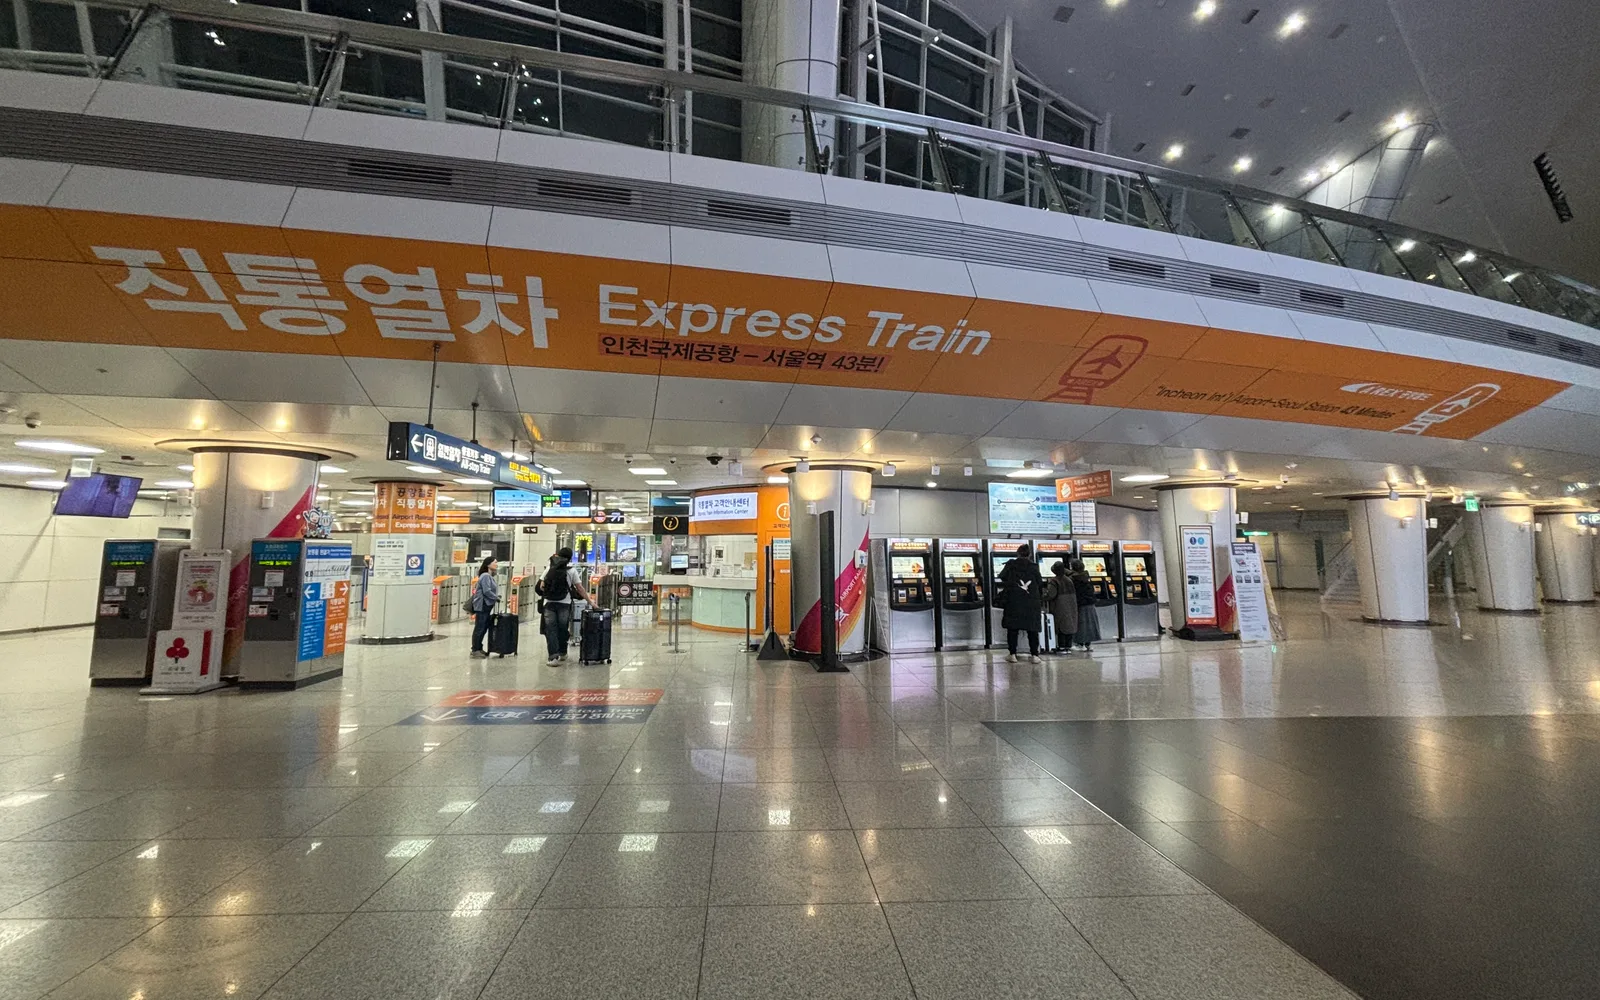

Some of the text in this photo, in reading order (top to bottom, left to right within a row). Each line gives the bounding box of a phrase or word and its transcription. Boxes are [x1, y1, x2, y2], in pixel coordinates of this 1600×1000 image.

[91, 245, 559, 349] 직통열차
[599, 284, 992, 356] Express Train
[602, 336, 739, 363] 인천국제공항
[763, 349, 827, 369] 서울역
[832, 355, 885, 373] 43분!
[397, 487, 433, 498] 공항철도
[396, 498, 433, 510] 직통열차
[714, 497, 750, 508] 고객안내센터
[395, 522, 420, 530] Express
[840, 579, 856, 601] AIRPORT
